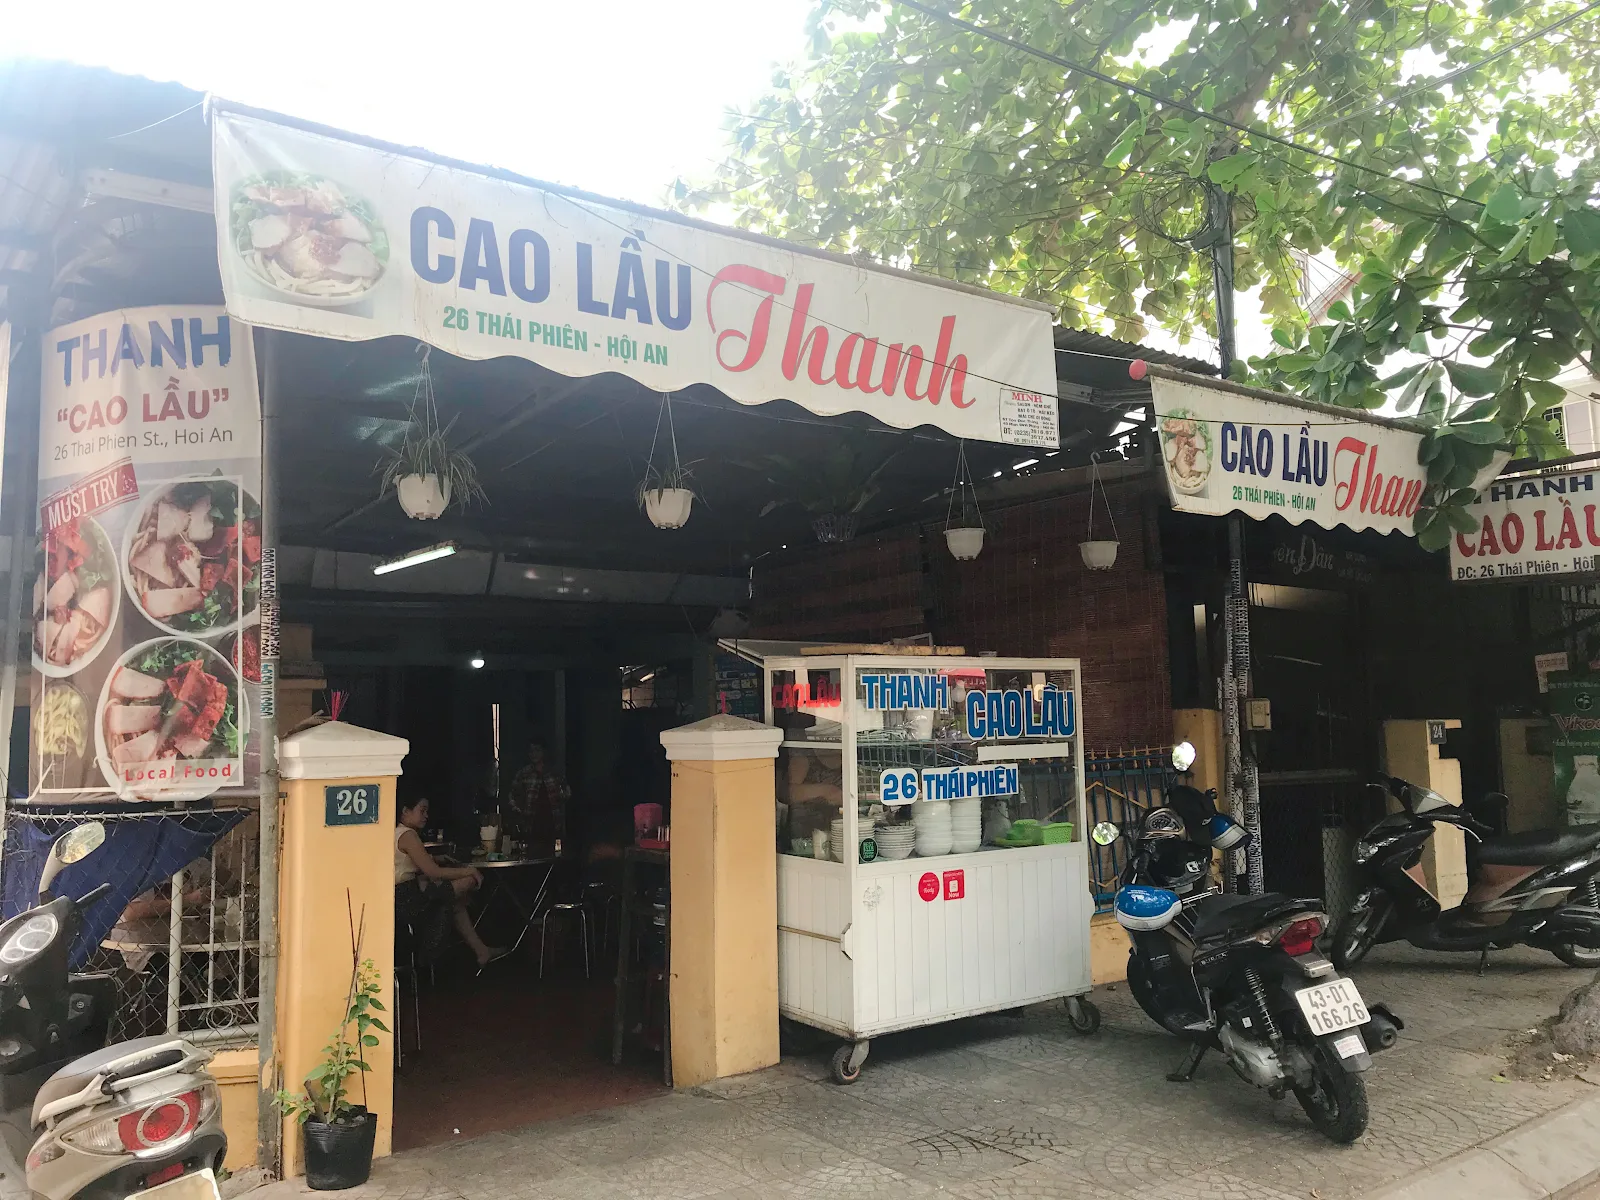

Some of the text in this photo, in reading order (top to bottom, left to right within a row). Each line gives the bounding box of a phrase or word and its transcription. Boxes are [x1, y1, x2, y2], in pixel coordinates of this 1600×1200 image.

[410, 206, 692, 331] CAO LẦU
[57, 316, 232, 387] THANH
[443, 306, 469, 331] 26
[476, 311, 522, 341] THÁI
[529, 321, 588, 352] PHIÊN
[607, 335, 638, 364] HỘI
[643, 344, 668, 366] AN
[706, 263, 976, 409] Thanh
[1012, 392, 1043, 403] MINH
[54, 427, 233, 461] 26 Thai Phien St., Hoi An
[1221, 421, 1328, 486] CAO LẦU
[1332, 436, 1422, 518] Than
[1473, 475, 1593, 504] HANH
[48, 475, 119, 530] MUST TRY
[1233, 486, 1243, 499] 26
[1245, 486, 1261, 504] THÁI
[1263, 489, 1285, 507] PHIÊN
[1292, 492, 1303, 512] HỘI
[1305, 497, 1316, 511] AN
[1456, 512, 1501, 557] CAO
[1458, 566, 1477, 579] ĐC:
[1480, 565, 1495, 577] 26
[1498, 562, 1522, 576] Thái
[1527, 560, 1559, 574] Phiên
[862, 675, 948, 710] THANH
[966, 690, 1022, 739] CAO
[1433, 725, 1443, 738] 24
[125, 763, 232, 782] Local Food
[883, 766, 1017, 800] 26 THÁI PHIÊN
[337, 789, 367, 815] 26
[1311, 1002, 1366, 1032] 166.26
